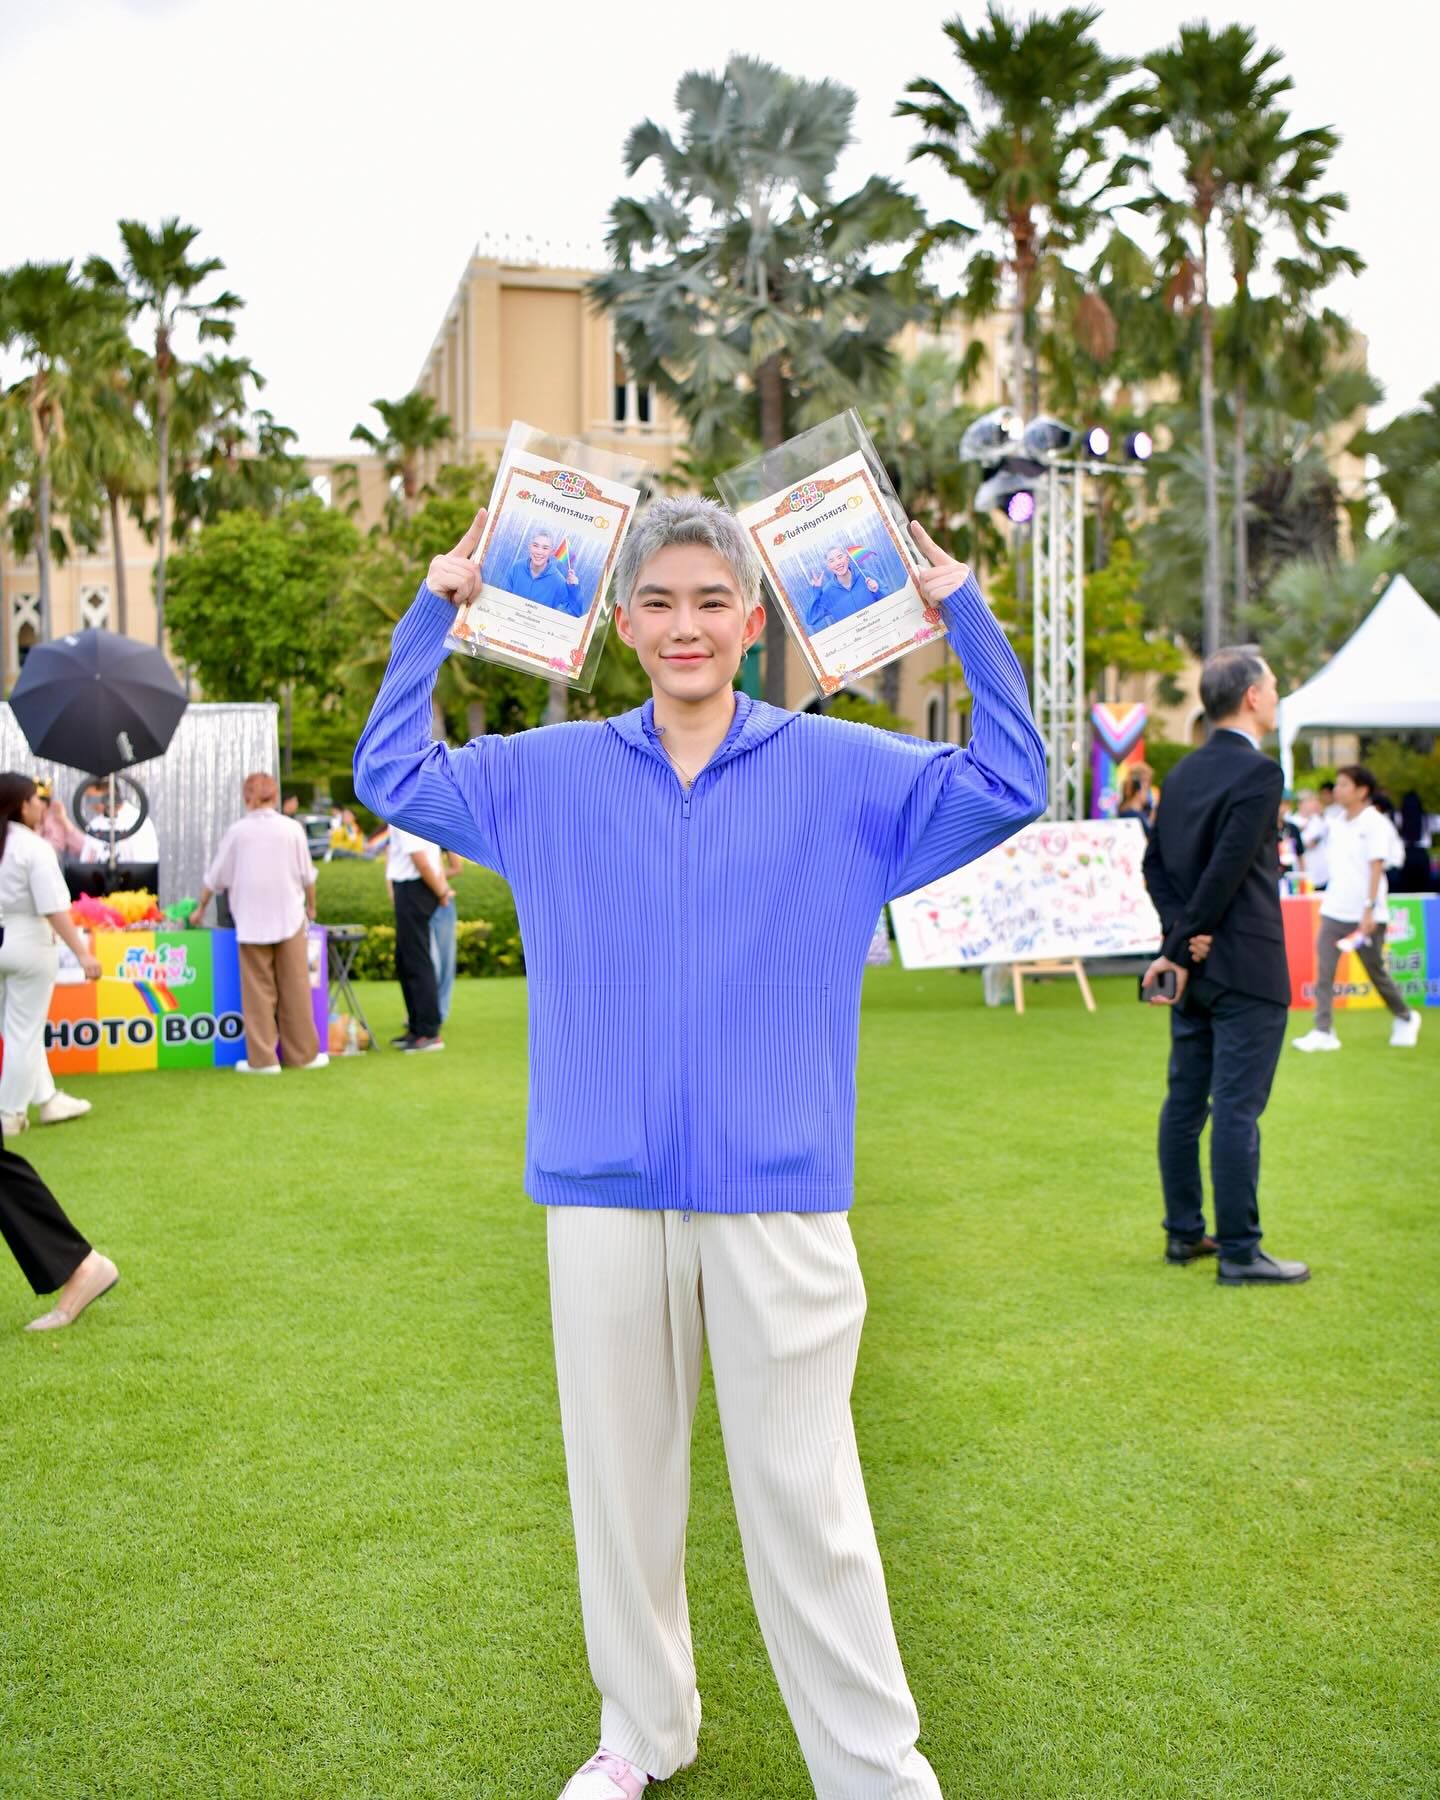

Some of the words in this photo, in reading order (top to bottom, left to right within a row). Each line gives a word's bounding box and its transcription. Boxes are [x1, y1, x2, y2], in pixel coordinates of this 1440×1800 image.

[530, 494, 595, 523] ใบสำคัญการสมรส
[785, 503, 848, 539] ใบสำคัญการสมรส
[44, 1018, 154, 1047] HOTO
[165, 1015, 244, 1042] BOO
